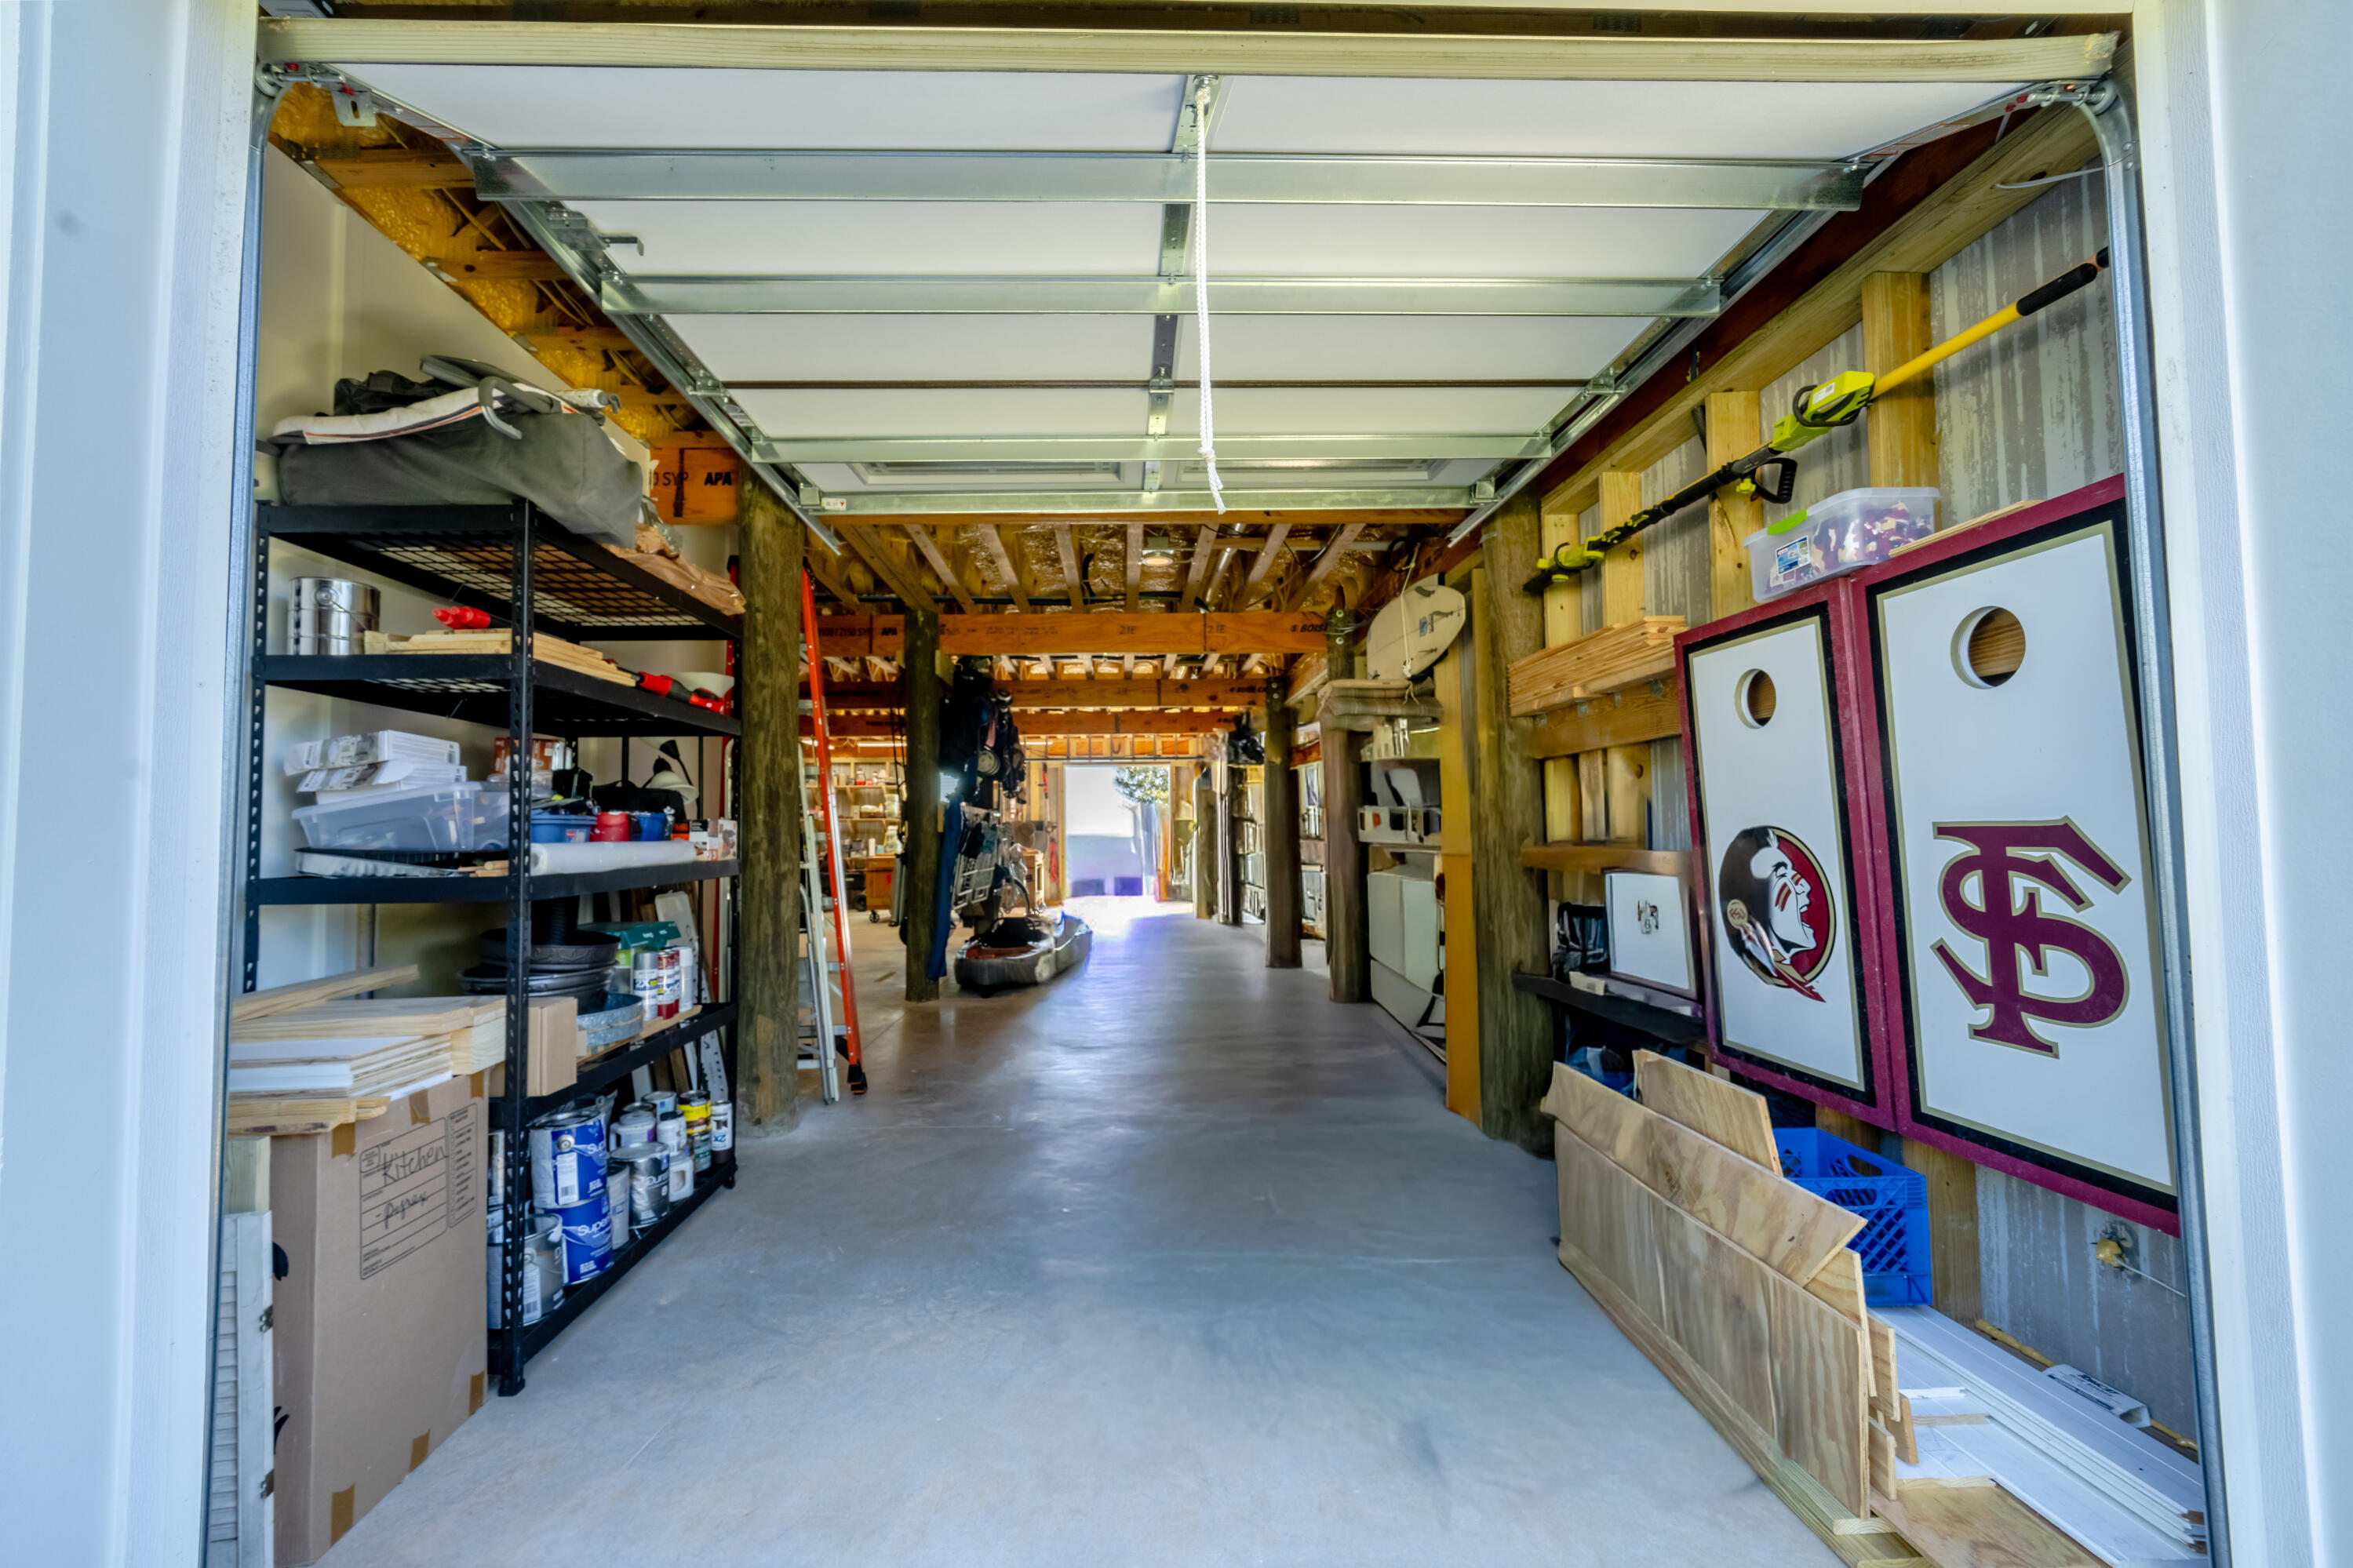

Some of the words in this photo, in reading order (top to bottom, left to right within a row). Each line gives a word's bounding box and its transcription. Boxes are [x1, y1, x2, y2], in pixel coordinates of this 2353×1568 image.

[704, 472, 732, 486] APA
[880, 628, 898, 636] APA
[382, 1146, 450, 1187] Kitchen
